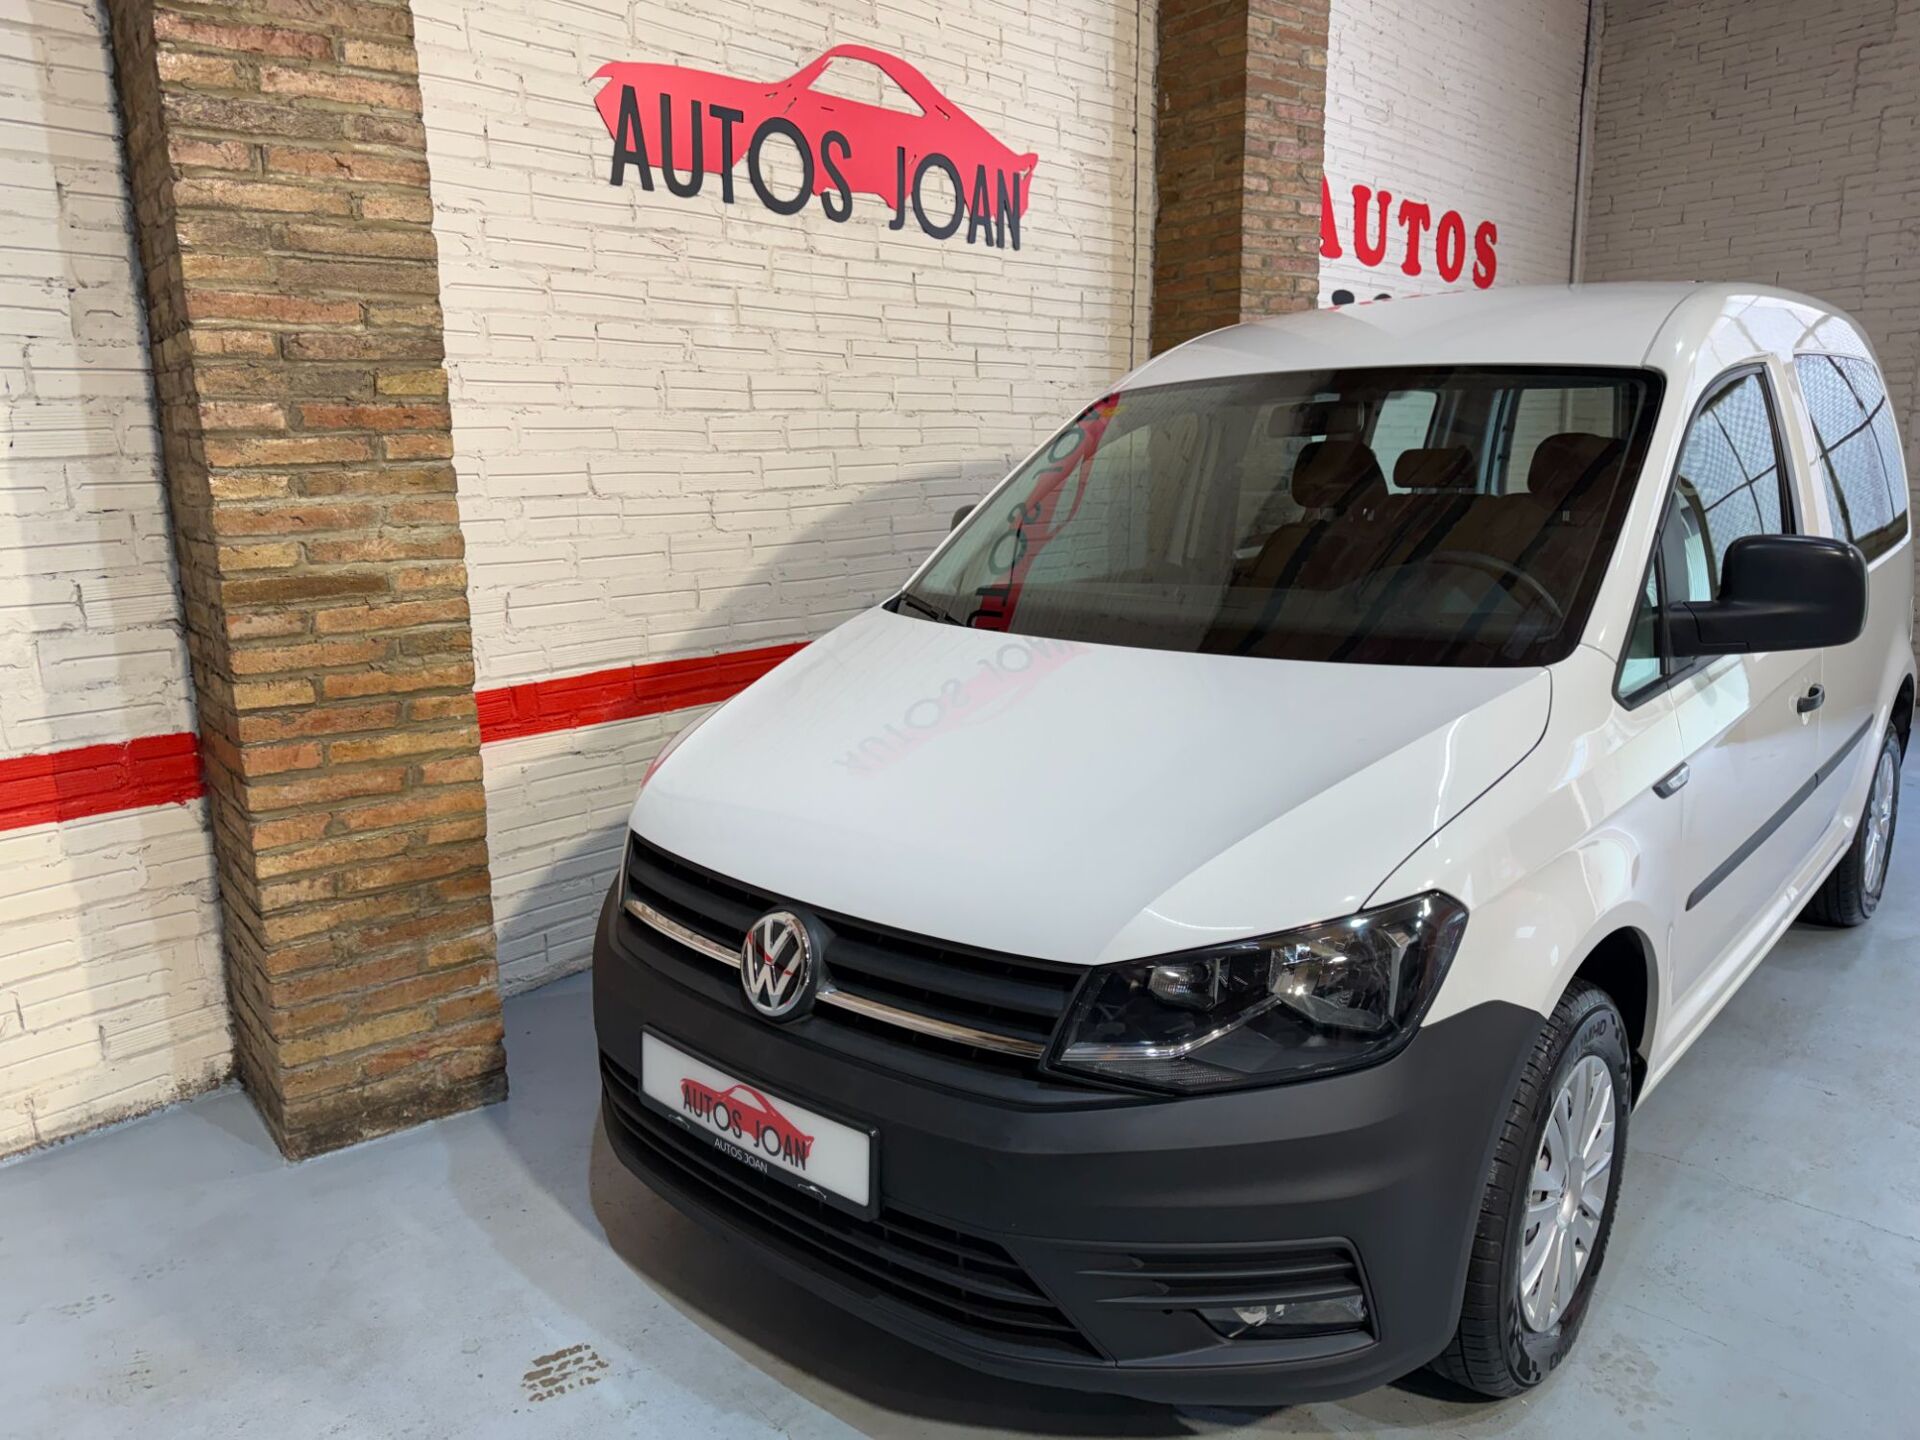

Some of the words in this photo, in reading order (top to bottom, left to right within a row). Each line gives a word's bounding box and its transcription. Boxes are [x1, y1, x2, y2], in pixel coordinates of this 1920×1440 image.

[609, 83, 853, 223] AUTOS
[889, 146, 1021, 251] JOAN
[682, 1082, 743, 1139] AUTOS
[753, 1119, 807, 1171] JOAN
[714, 1137, 743, 1161] AUTOS
[744, 1152, 768, 1174] JOAN
